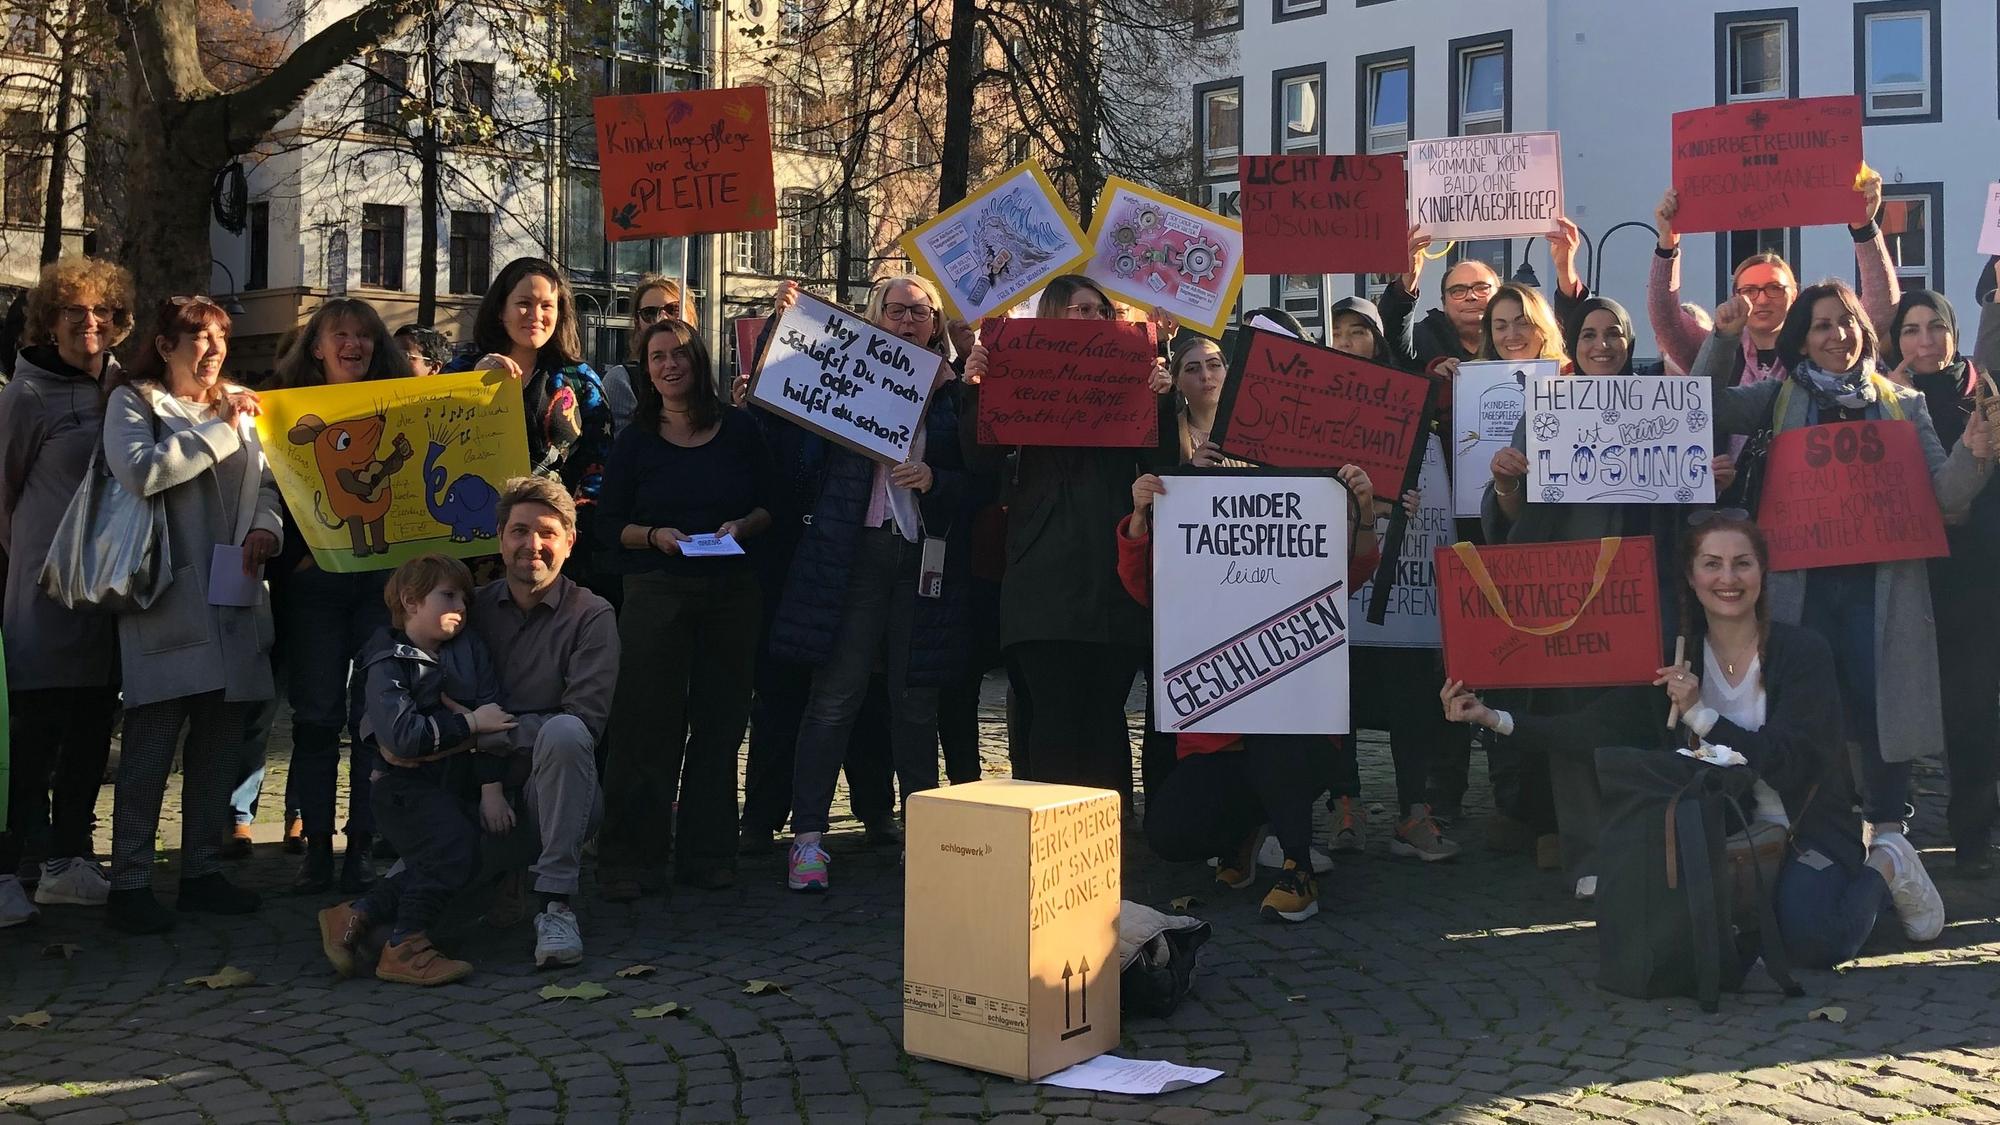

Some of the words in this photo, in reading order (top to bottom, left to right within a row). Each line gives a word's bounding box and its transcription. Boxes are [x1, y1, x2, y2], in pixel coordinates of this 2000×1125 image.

[605, 118, 754, 154] Kindertagespflege
[1419, 136, 1529, 161] KINDERFREUNLICHE
[646, 160, 669, 174] vor
[684, 153, 710, 172] der
[1247, 155, 1324, 185] LICHT
[1330, 155, 1383, 183] AUS
[1428, 157, 1487, 176] KOMMUNE
[1497, 154, 1526, 172] KÖLN
[1742, 153, 1779, 167] KEIN
[631, 172, 740, 213] PLEITE
[1444, 174, 1478, 194] BALD
[1482, 172, 1517, 192] OHNE
[1683, 163, 1846, 198] PERSONALMANGEL
[1244, 191, 1277, 212] IST
[1292, 190, 1369, 211] KEINE
[1418, 189, 1556, 224] KINDERTAGESPFLEGE?
[1246, 213, 1380, 240] LÖSUNG!!!
[824, 314, 860, 350] Hey
[866, 334, 916, 376] Köln,
[852, 358, 876, 385] Du
[1265, 348, 1314, 378] Wir
[1328, 371, 1392, 403] sind
[820, 372, 864, 399] oder
[1066, 388, 1128, 405] WÄRME
[1533, 379, 1644, 411] HEIZUNG
[1651, 379, 1702, 411] AUS
[782, 377, 832, 414] hilfst
[831, 403, 853, 423] du
[853, 415, 911, 450] schon?
[1483, 400, 1520, 410] KINDER-
[985, 407, 1088, 432] Soforthilfe
[1578, 424, 1615, 444] ist
[1805, 423, 1886, 469] SOS
[1538, 443, 1708, 489] LÖSUNG
[1786, 467, 1839, 496] FRAU
[1212, 492, 1302, 520] KINDER
[1775, 496, 1833, 524] BITTE
[1839, 487, 1912, 518] KOMMEN
[1178, 523, 1328, 558] TAGESPFLEGE
[1219, 560, 1281, 585] leider
[1166, 594, 1346, 717] GESCHLOSSEN
[1544, 631, 1610, 657] HELFEN
[941, 843, 984, 857] schlagwerk
[987, 1015, 1025, 1028] schlagwerk
